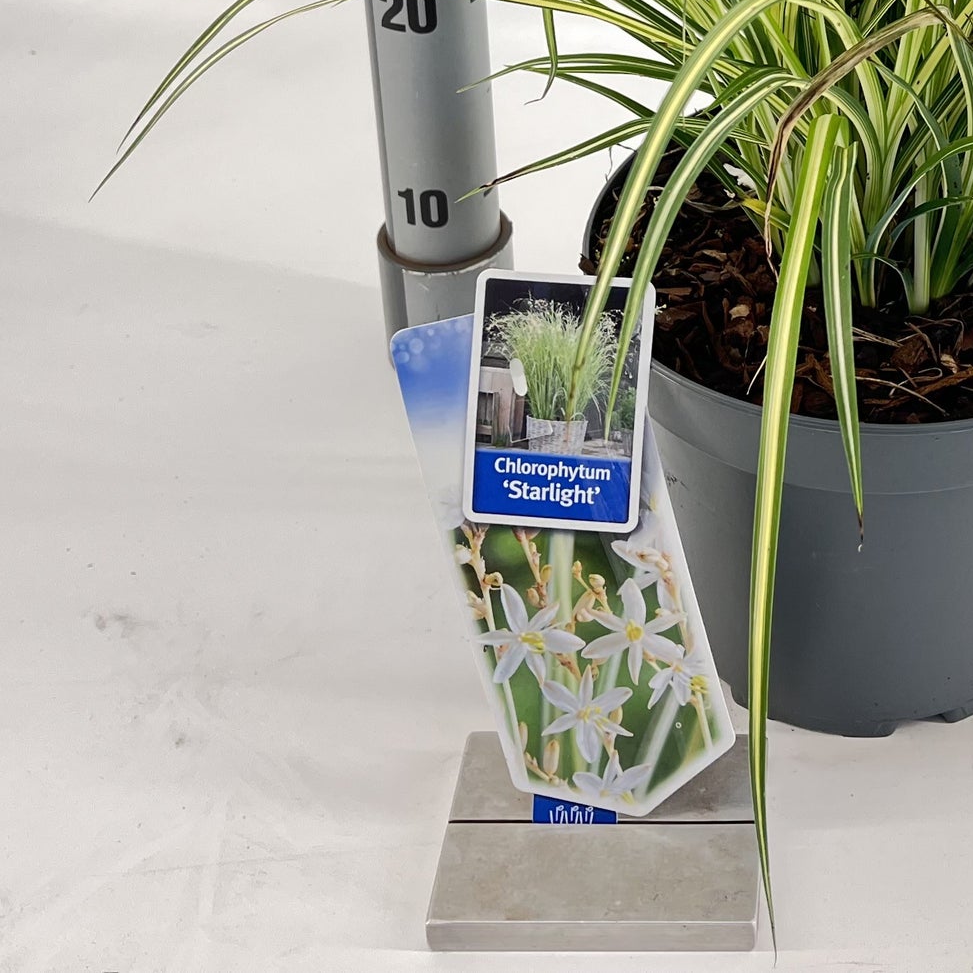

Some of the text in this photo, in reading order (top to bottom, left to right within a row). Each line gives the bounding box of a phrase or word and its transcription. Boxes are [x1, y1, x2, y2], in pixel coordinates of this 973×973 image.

[397, 187, 449, 229] 10
[494, 457, 611, 482] Chlorophytum
[502, 479, 601, 507] ‘Starlight’
